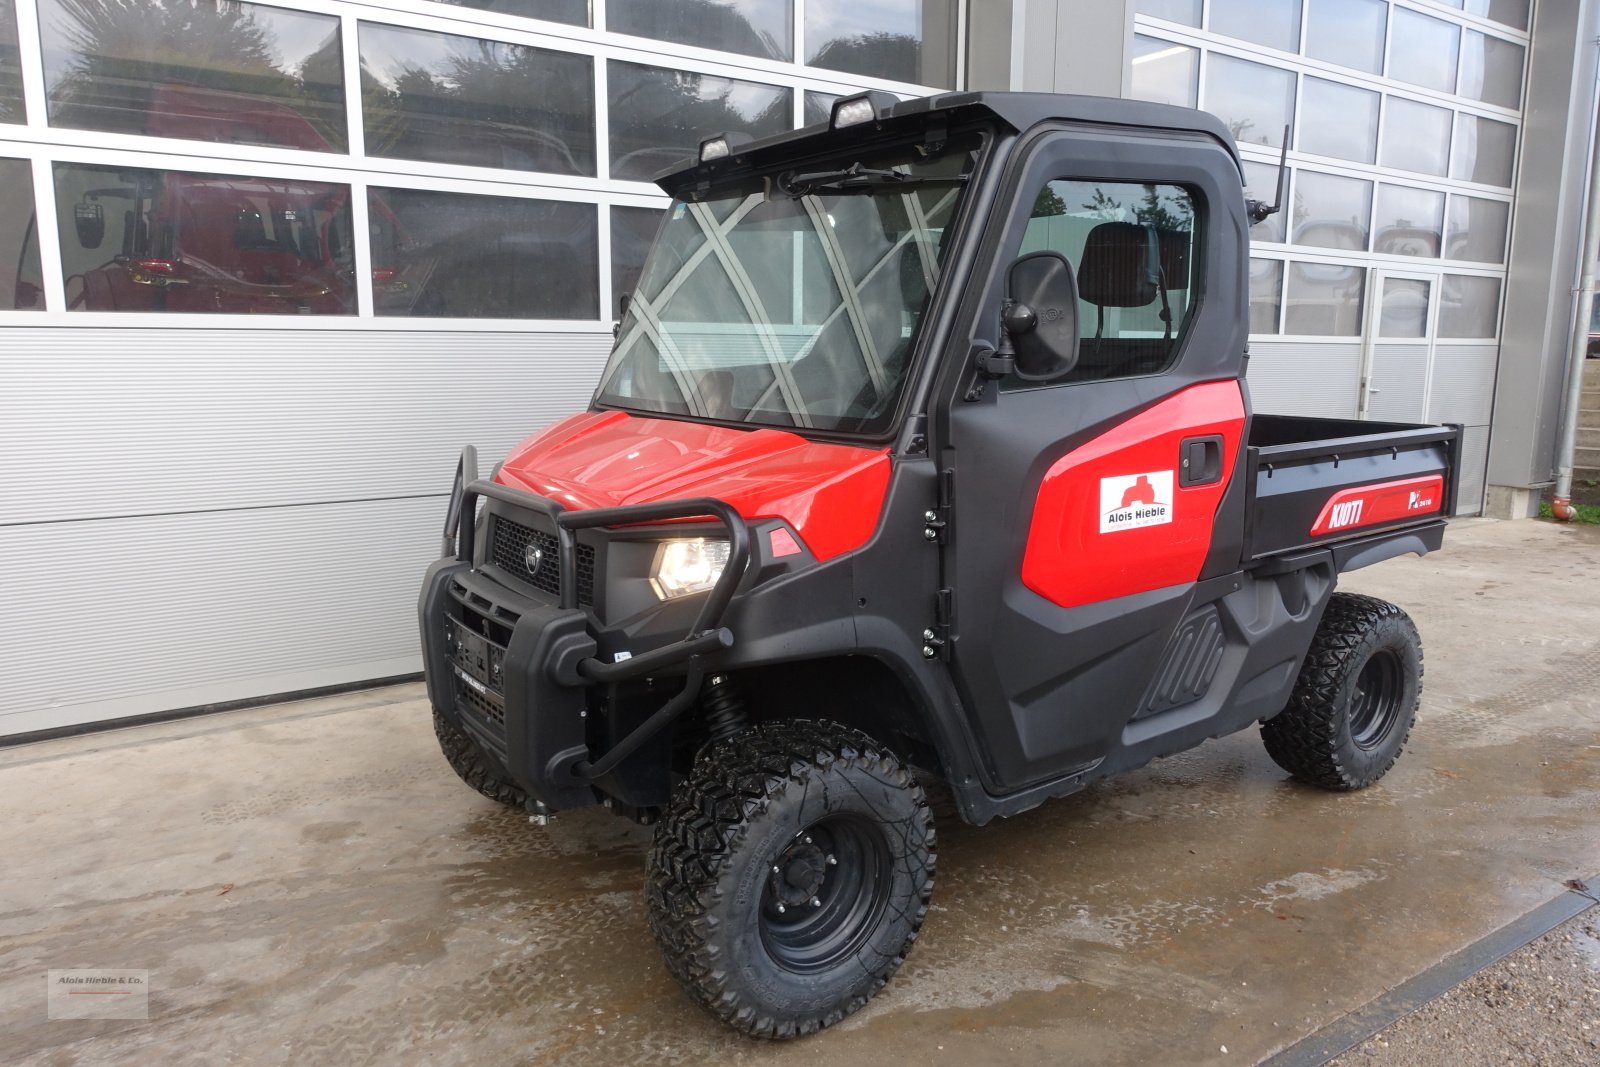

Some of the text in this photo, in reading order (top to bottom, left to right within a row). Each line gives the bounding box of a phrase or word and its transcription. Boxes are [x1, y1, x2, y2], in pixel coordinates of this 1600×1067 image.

[1108, 511, 1133, 524] Alois
[1135, 506, 1166, 519] Hieble
[1328, 499, 1364, 529] KIOTI
